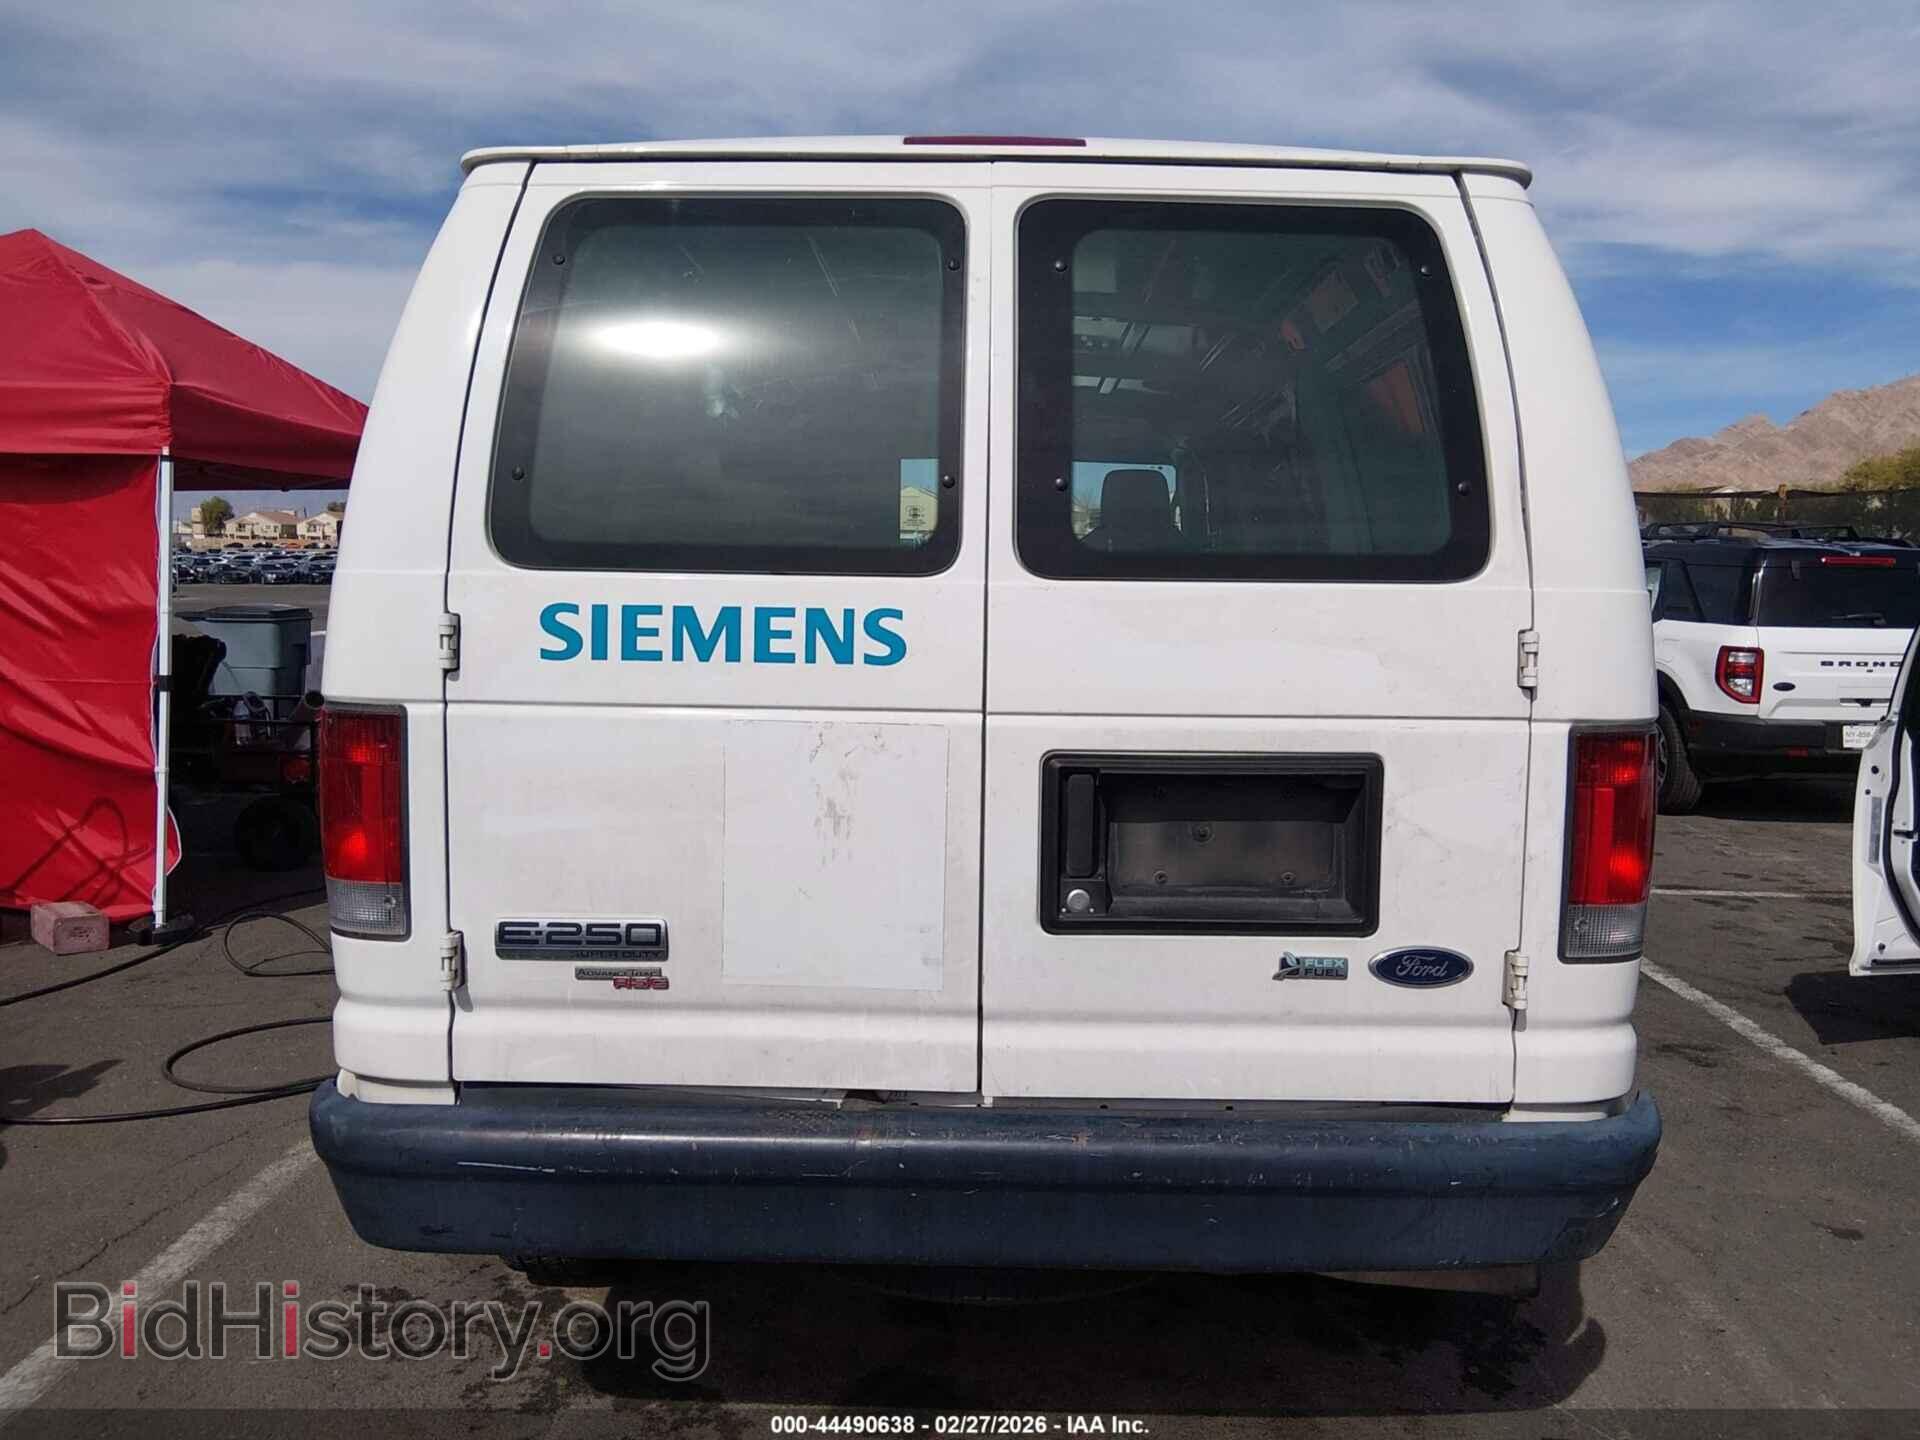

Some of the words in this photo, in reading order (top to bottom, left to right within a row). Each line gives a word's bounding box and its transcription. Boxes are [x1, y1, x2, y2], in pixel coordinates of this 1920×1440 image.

[539, 602, 907, 666] SIEMENS
[498, 921, 661, 945] E-250
[622, 951, 662, 960] DUTY
[1304, 958, 1345, 968] FLEX
[1303, 967, 1344, 977] FUEL
[1395, 955, 1449, 977] Ford
